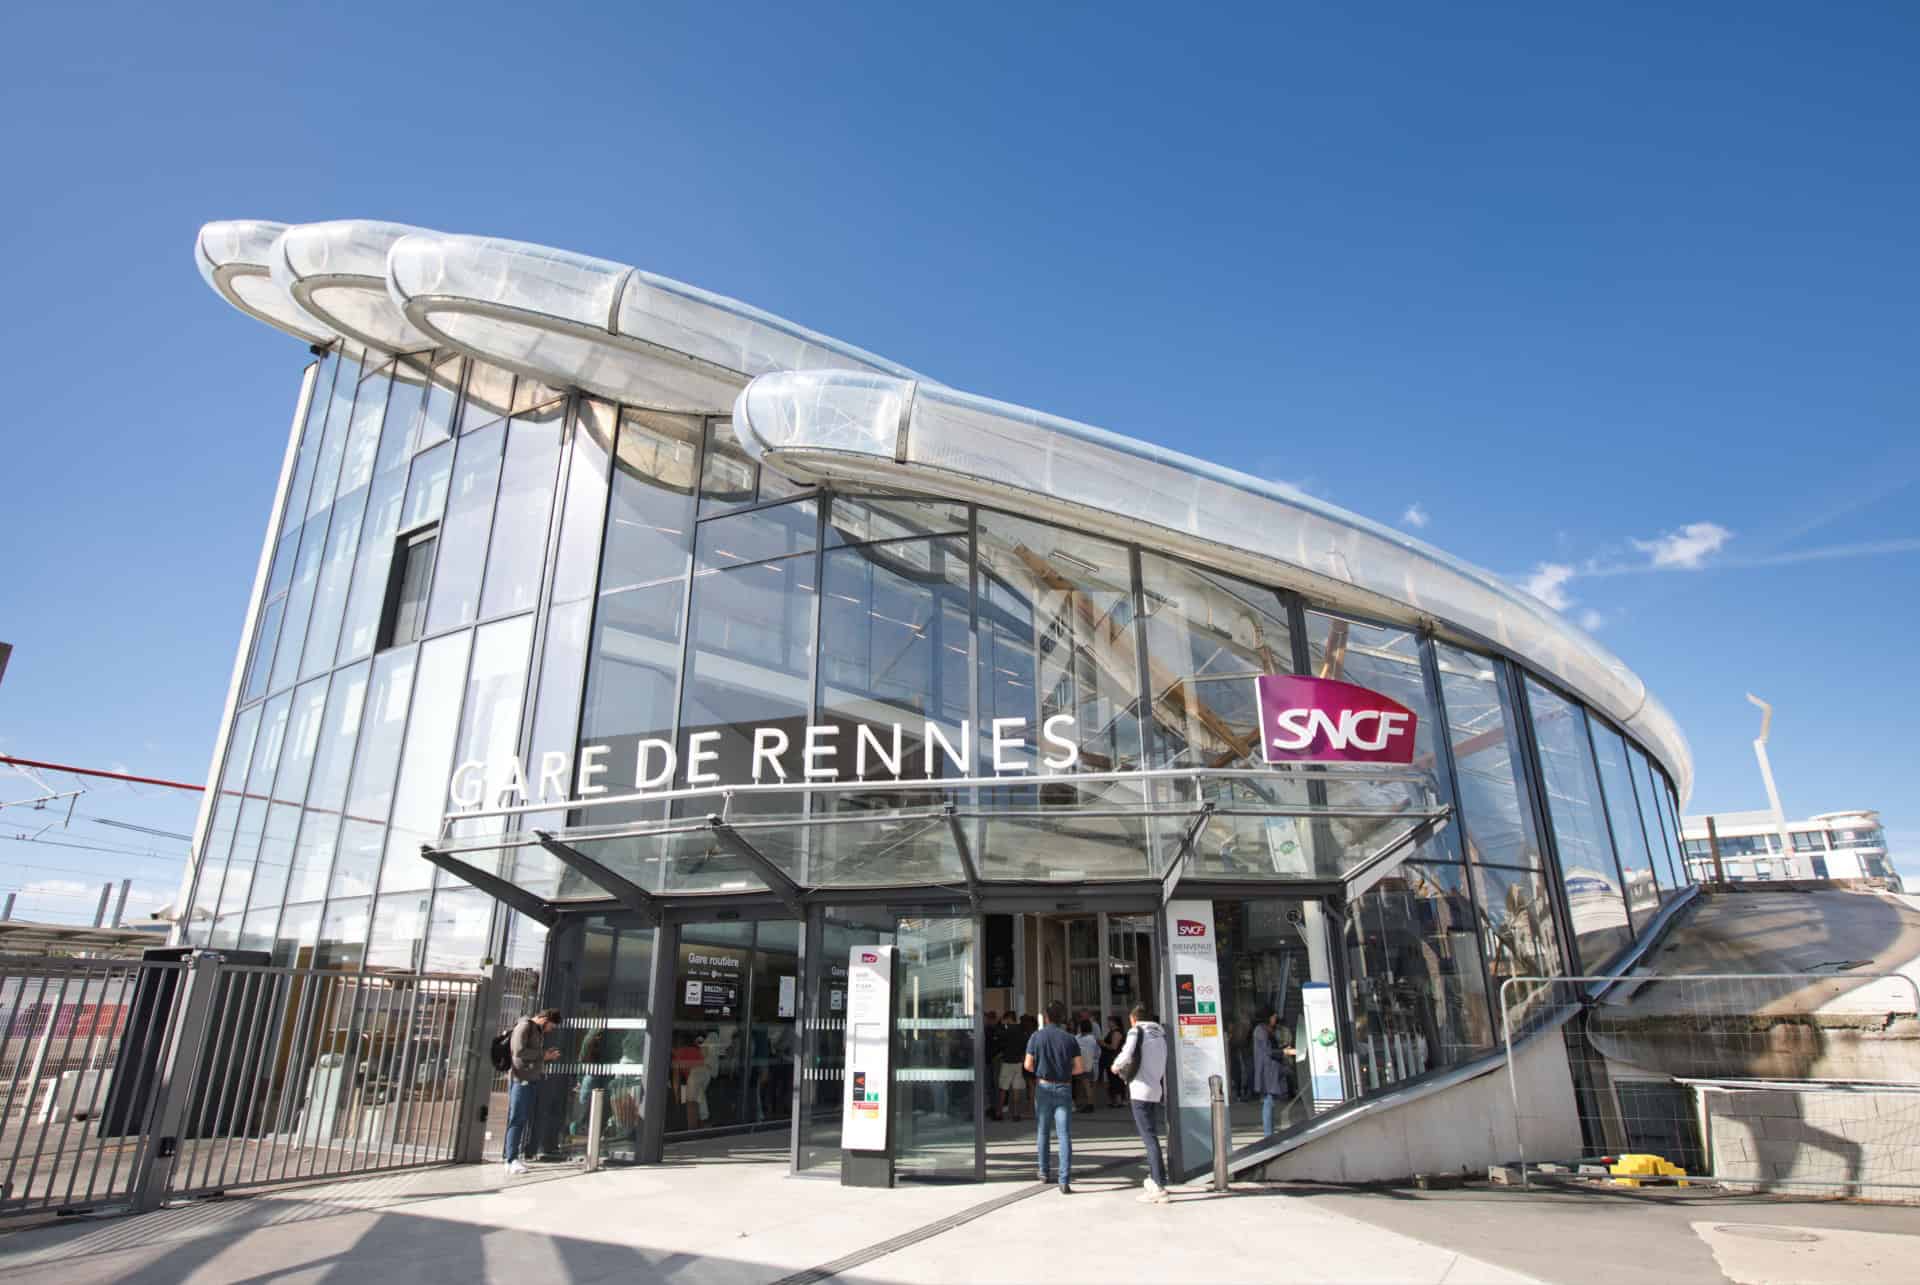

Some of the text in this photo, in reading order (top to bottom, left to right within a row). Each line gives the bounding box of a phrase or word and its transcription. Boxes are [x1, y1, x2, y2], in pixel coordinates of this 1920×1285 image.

[1272, 708, 1409, 751] SNCF
[451, 714, 1081, 807] GARE DE RENNES
[1179, 926, 1205, 936] SNCF
